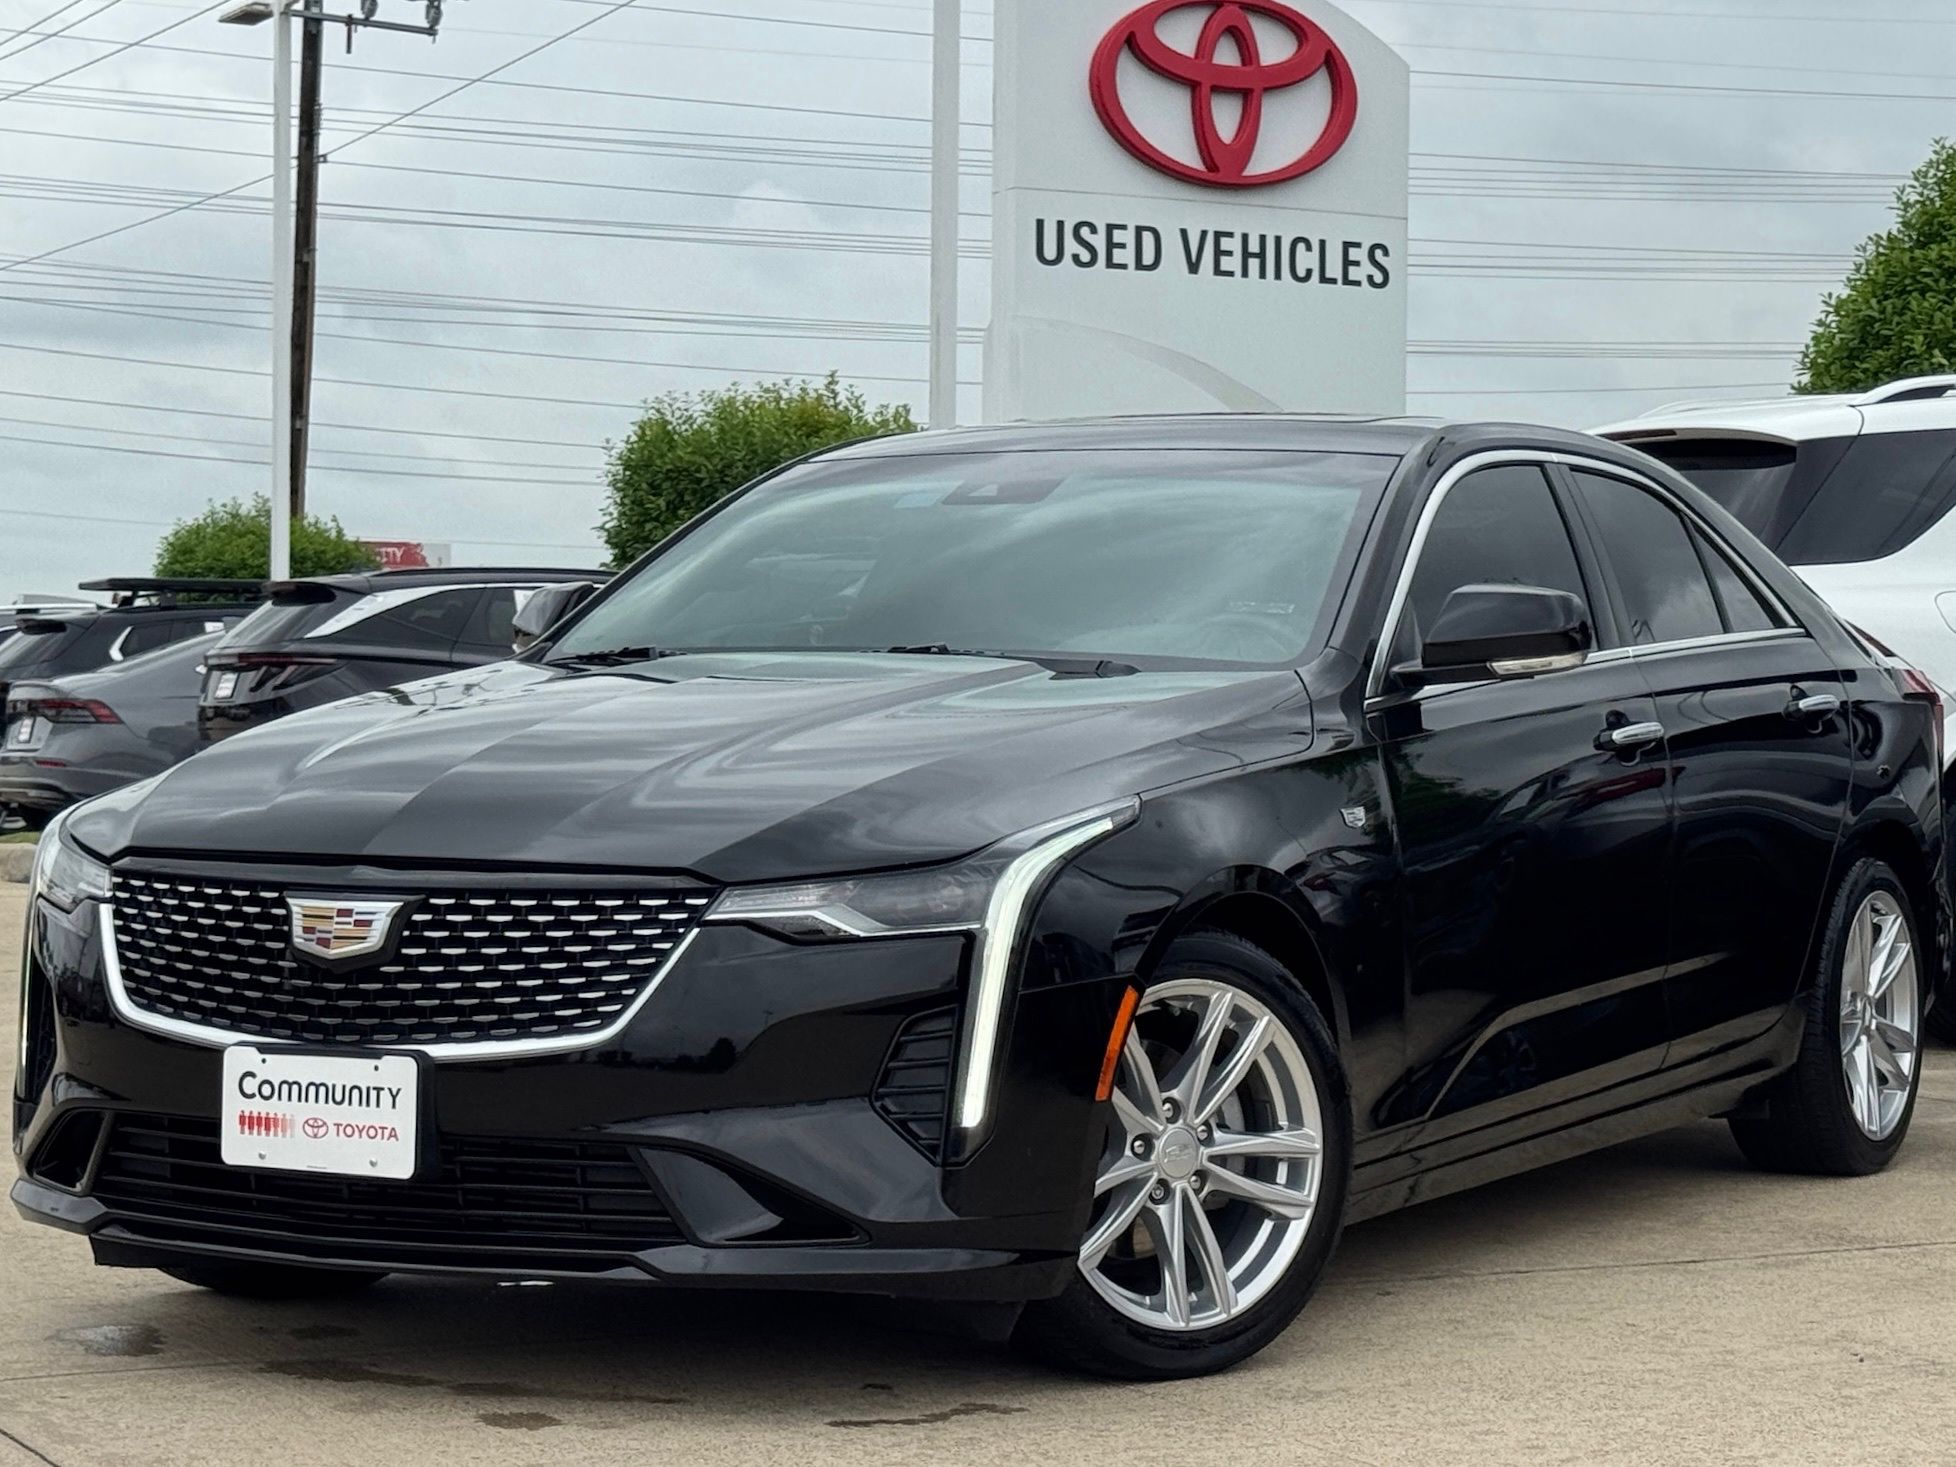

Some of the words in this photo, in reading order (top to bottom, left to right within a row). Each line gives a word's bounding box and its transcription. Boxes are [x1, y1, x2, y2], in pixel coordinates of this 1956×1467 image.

[1035, 218, 1162, 272] USED
[1179, 227, 1390, 290] VEHICLES
[333, 1122, 399, 1142] TOYOTA
